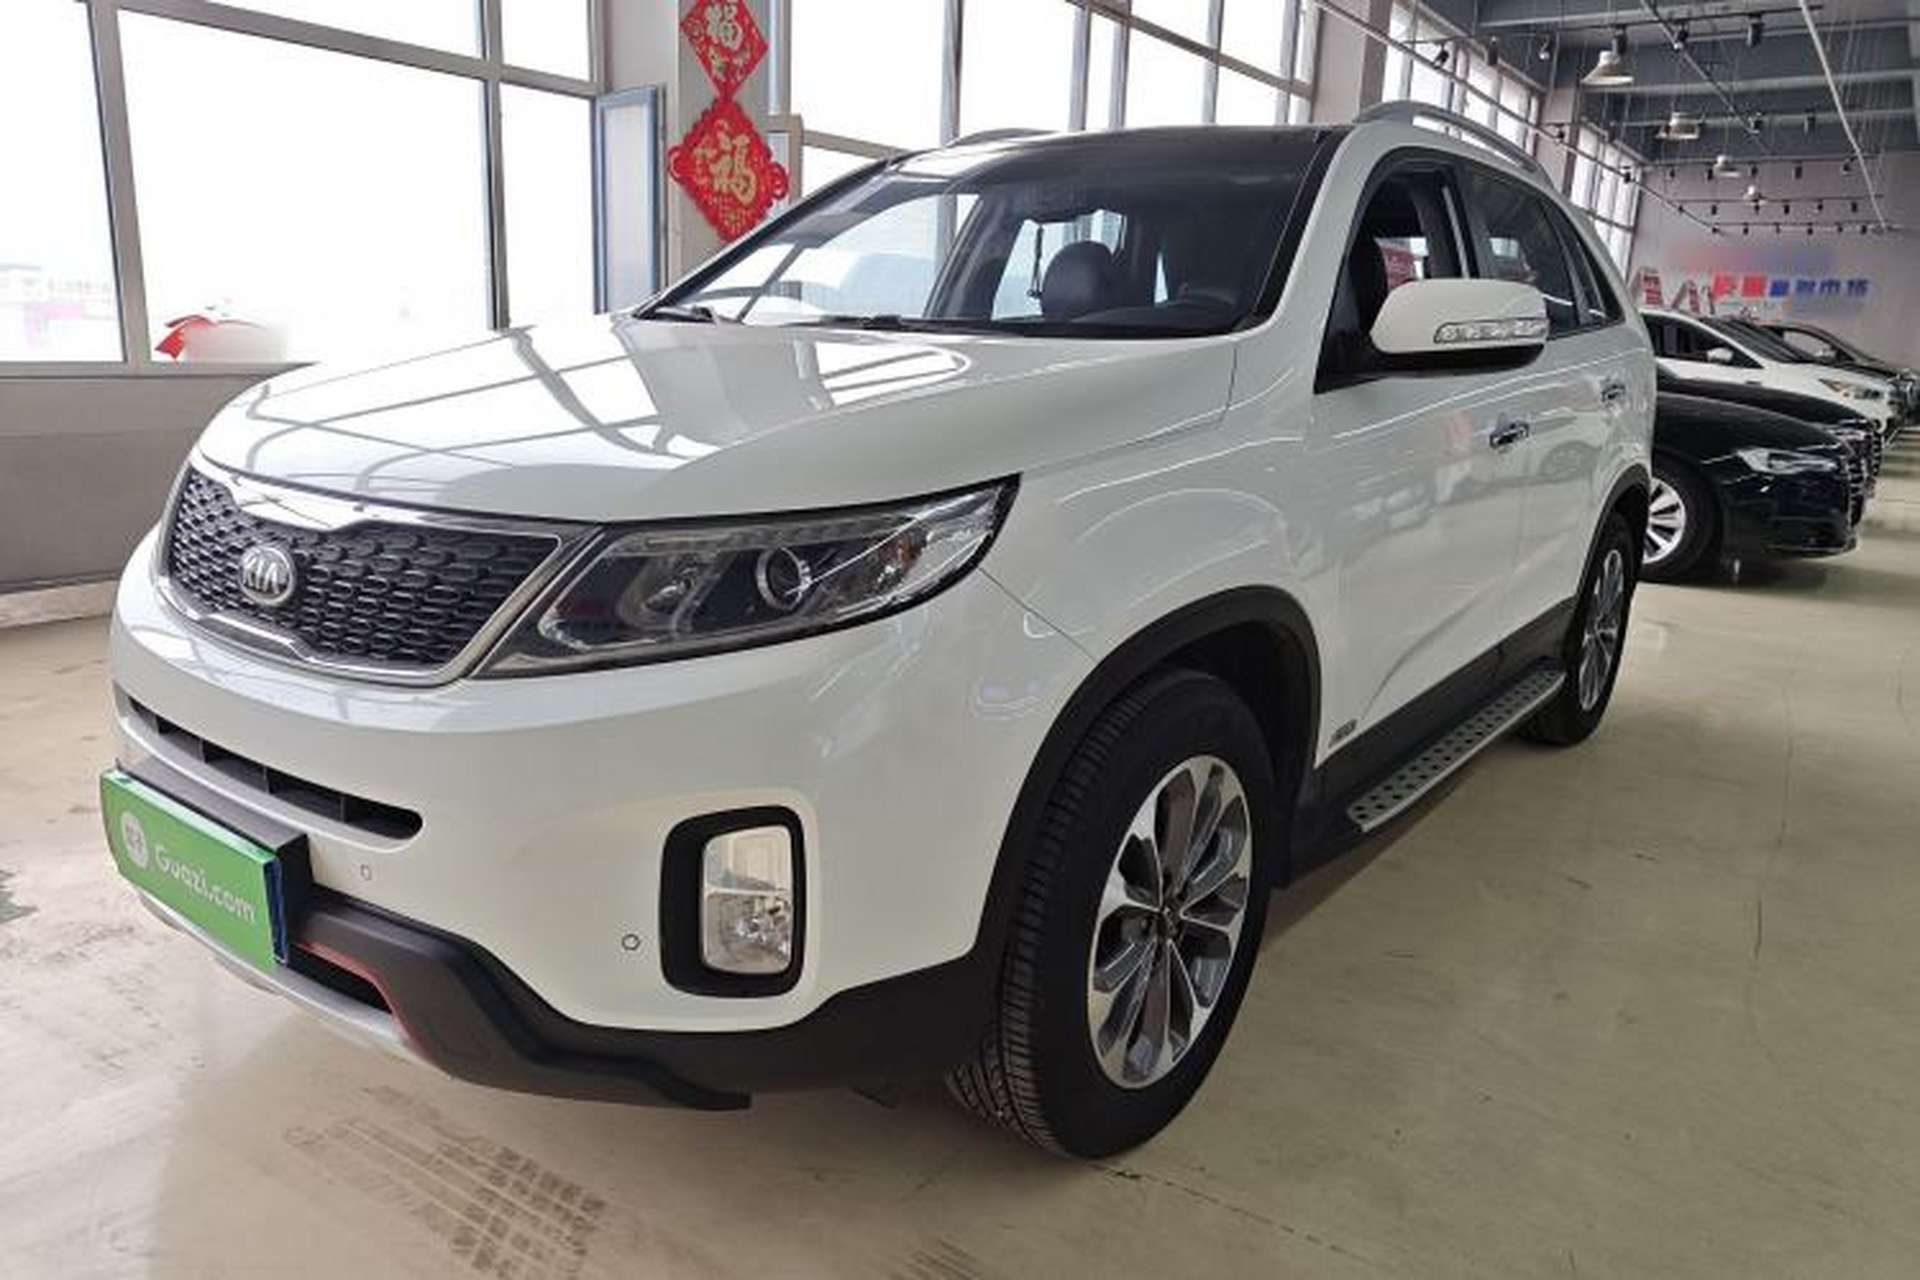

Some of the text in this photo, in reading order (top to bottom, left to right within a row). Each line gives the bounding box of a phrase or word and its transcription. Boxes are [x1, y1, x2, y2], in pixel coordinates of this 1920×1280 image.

[709, 130, 757, 206] 福
[243, 553, 281, 596] KIA
[154, 844, 257, 924] Guazi.com
